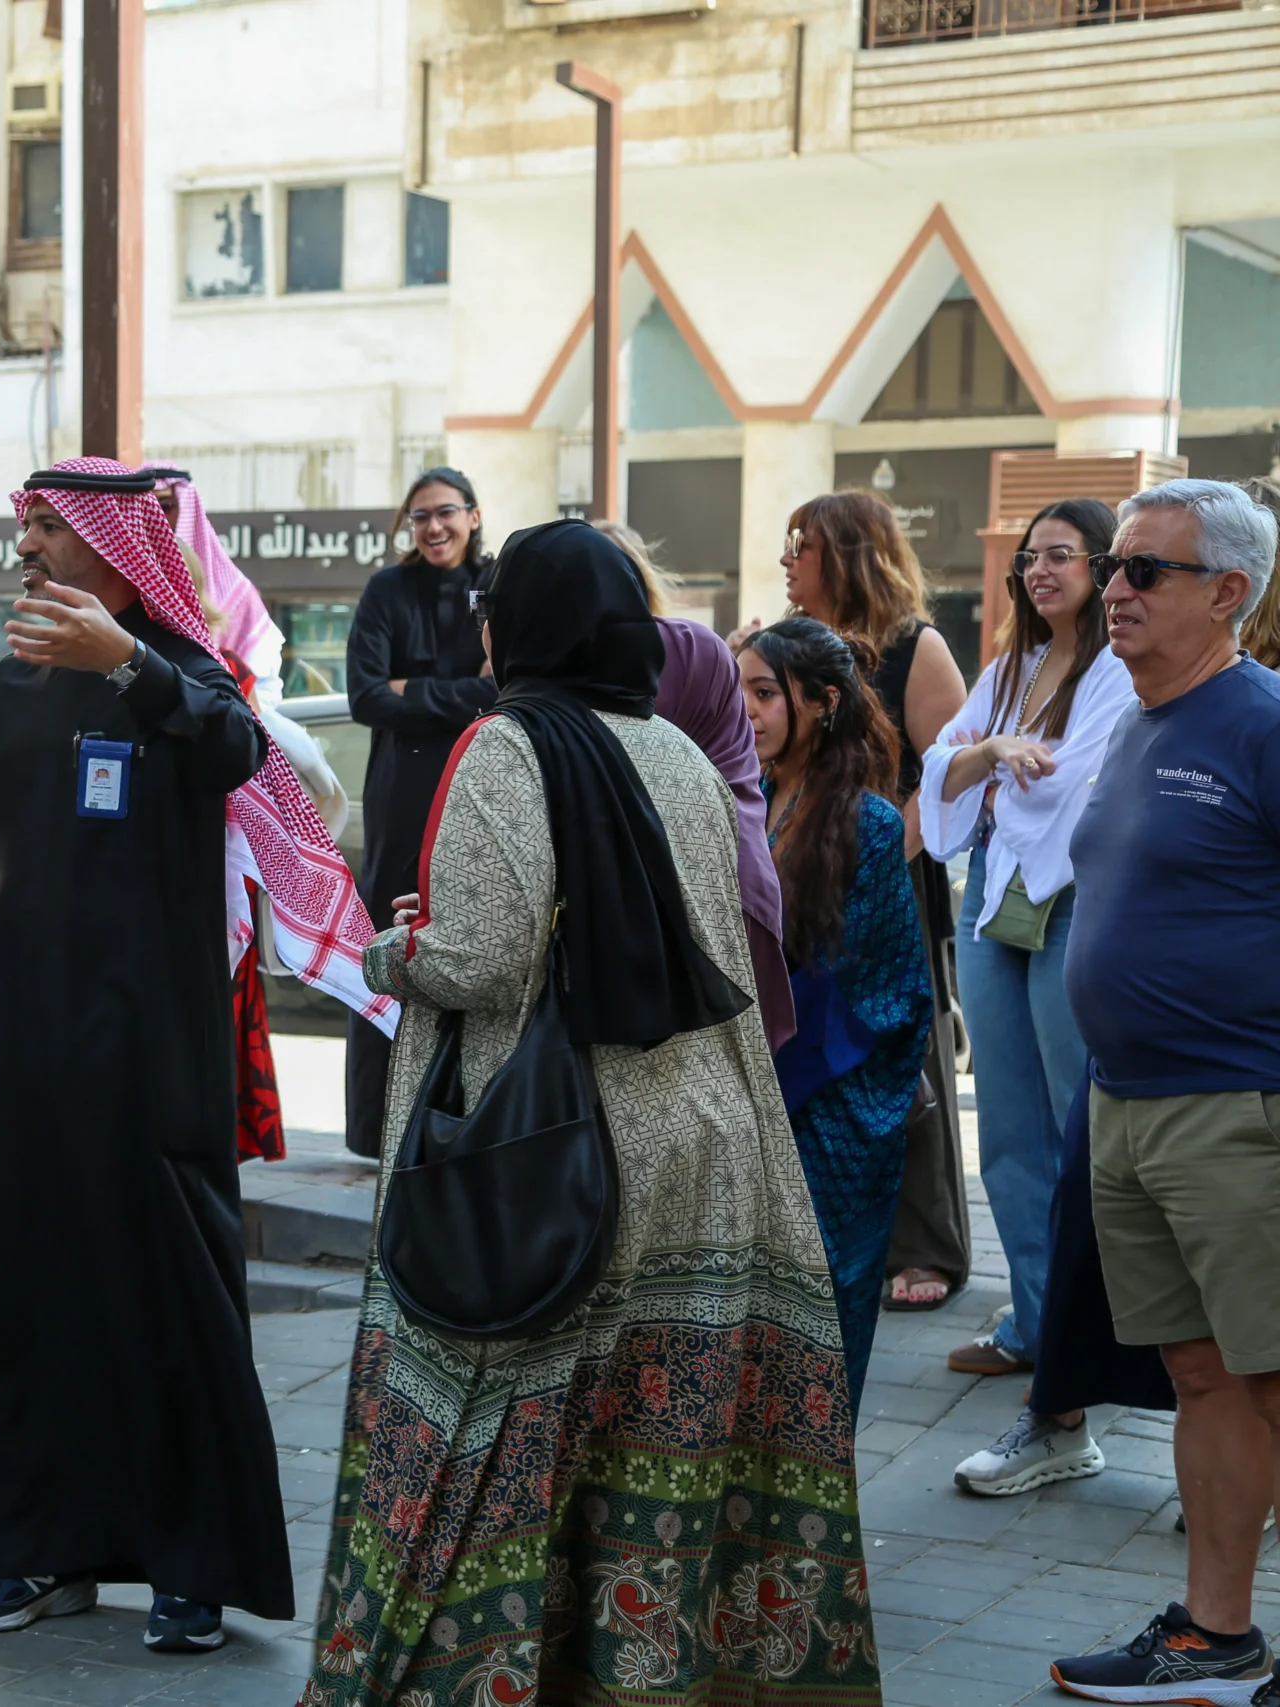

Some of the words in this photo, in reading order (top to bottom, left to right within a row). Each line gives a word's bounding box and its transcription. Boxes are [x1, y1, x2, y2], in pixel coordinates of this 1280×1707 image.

[257, 514, 350, 568] عبدالله
[354, 521, 387, 568] بن
[1156, 768, 1213, 783] wanderlust
